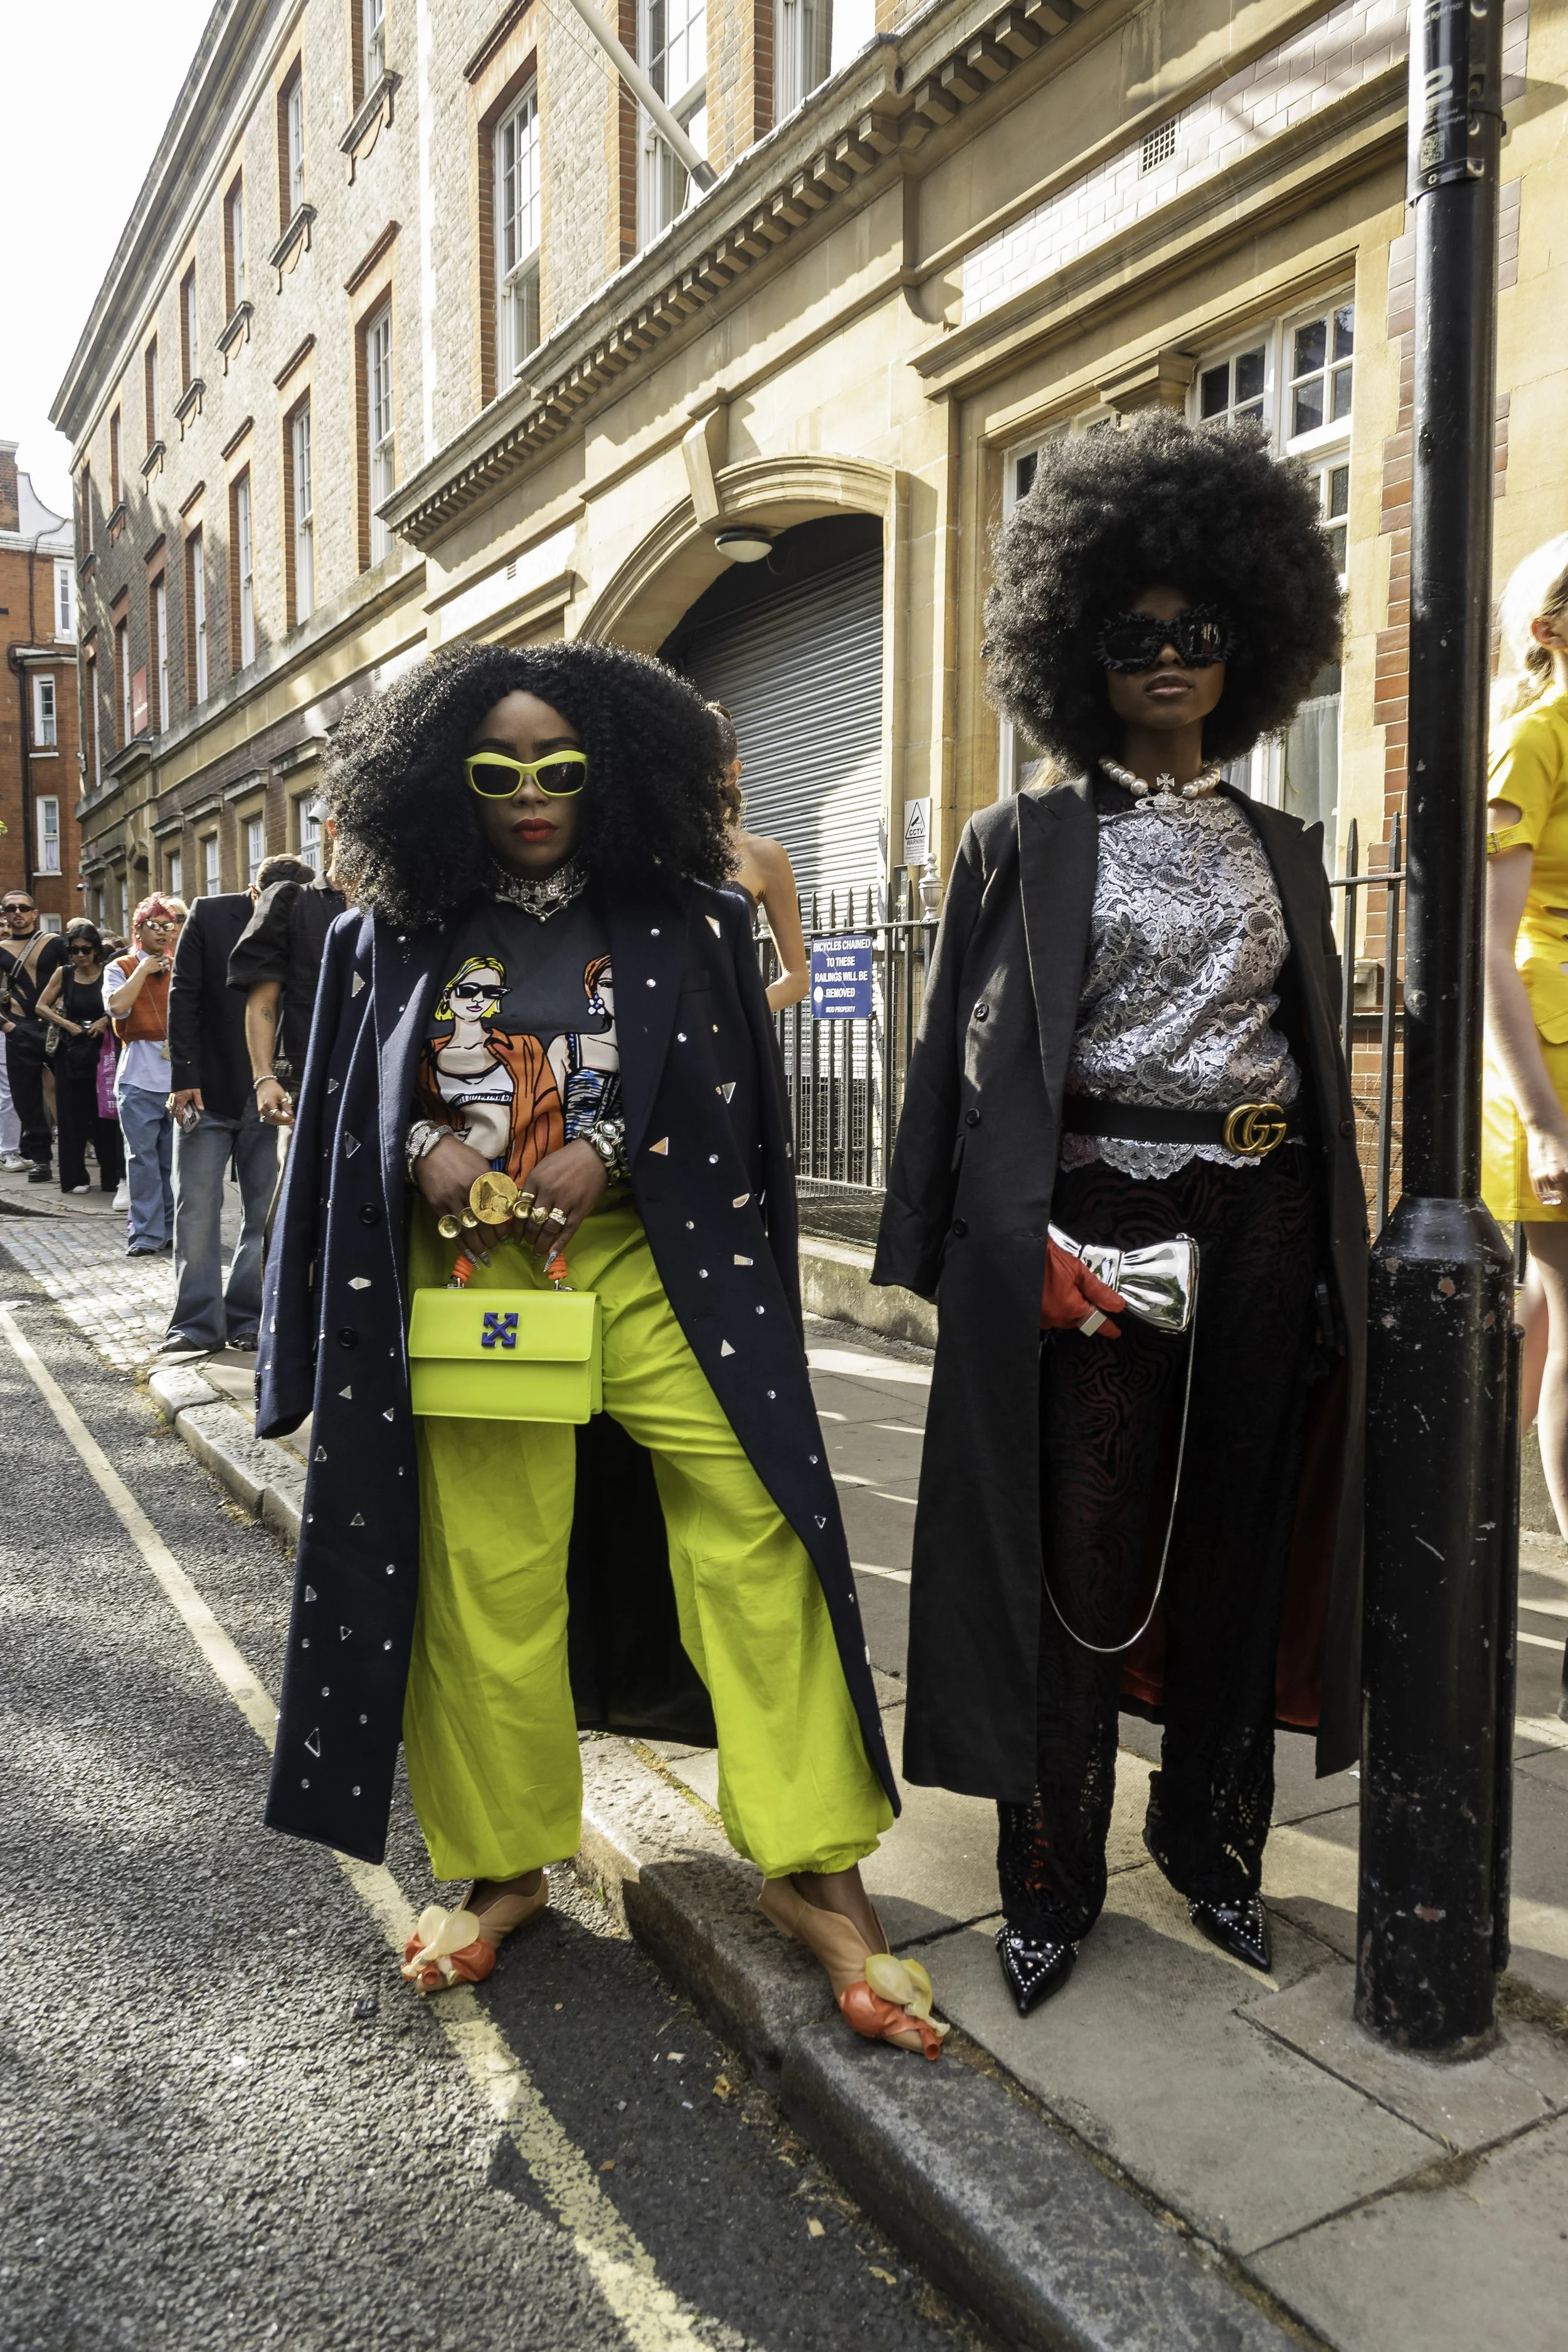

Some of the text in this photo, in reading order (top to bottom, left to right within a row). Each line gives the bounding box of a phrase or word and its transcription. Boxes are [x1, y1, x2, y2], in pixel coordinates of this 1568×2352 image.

[909, 828, 923, 836] CCTV
[813, 938, 871, 953] BICYCLES CHAINED
[826, 956, 856, 967] TO THESE
[815, 970, 868, 983] RAILINGS WILL BE
[825, 987, 856, 999] REMOVED
